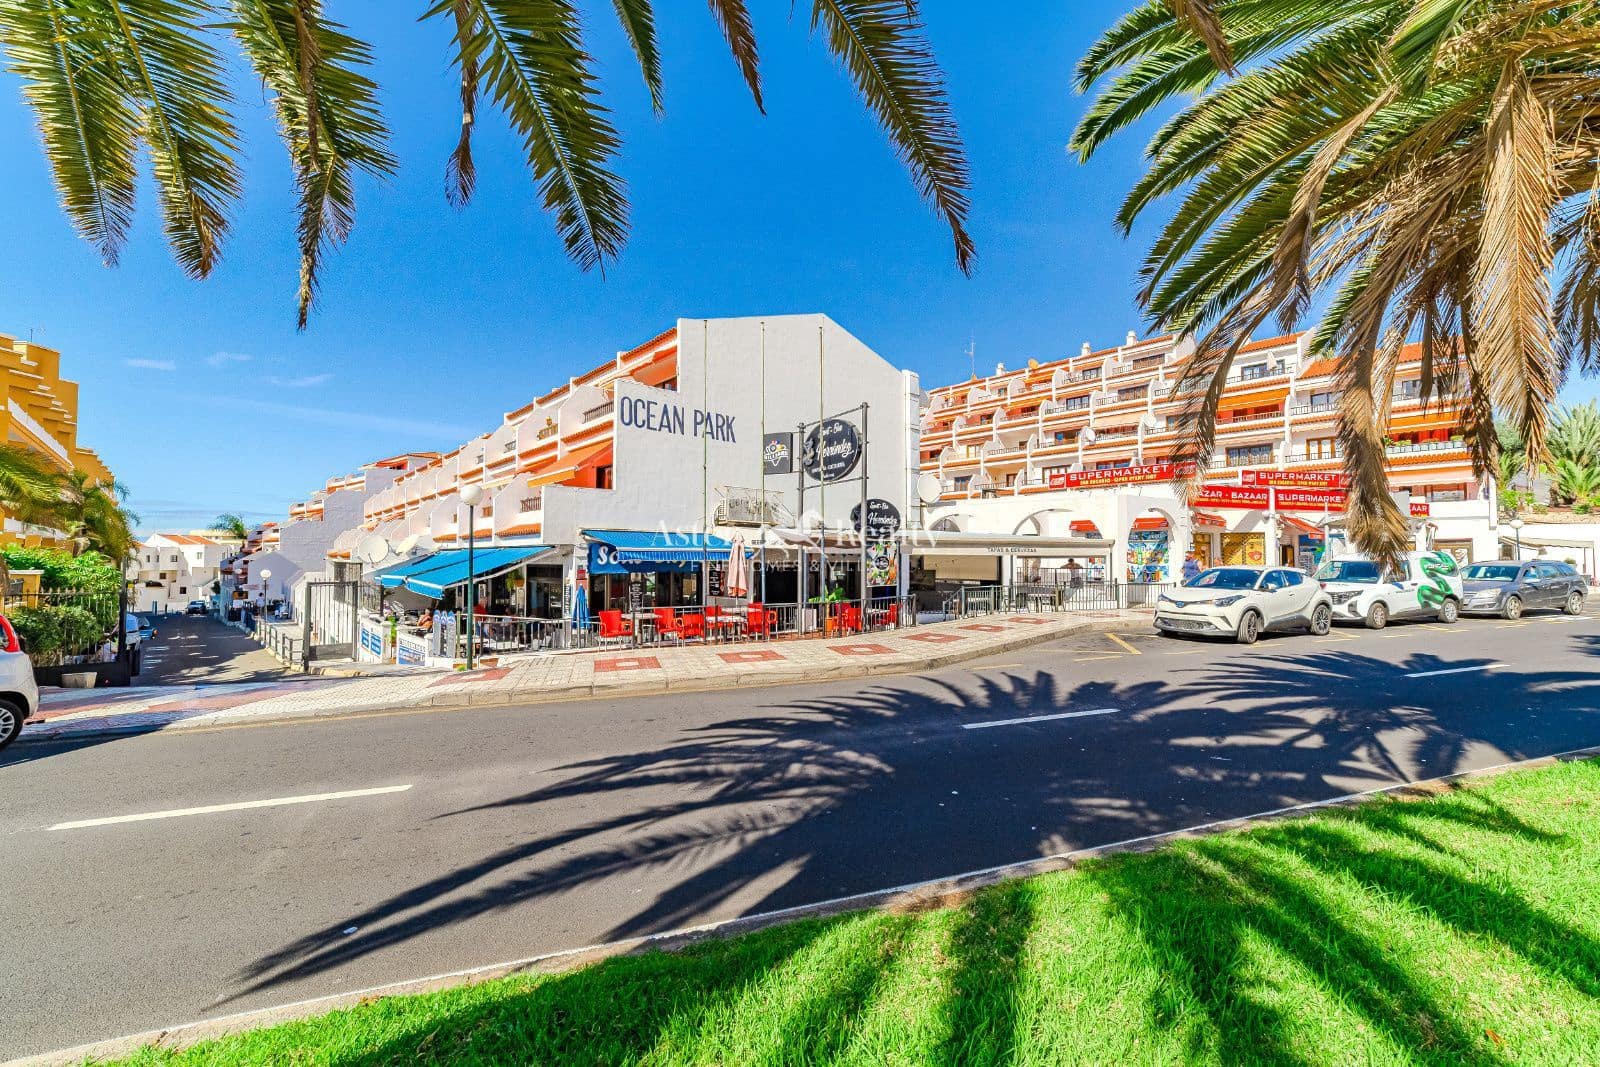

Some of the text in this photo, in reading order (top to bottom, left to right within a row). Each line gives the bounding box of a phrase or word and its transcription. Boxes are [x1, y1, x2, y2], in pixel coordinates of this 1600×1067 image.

[620, 396, 736, 443] OCEAN PARK
[1069, 465, 1169, 481] SUPERMARKET
[1259, 472, 1336, 481] SUPERMARKET
[1192, 490, 1267, 500] AZAR BAZAAR
